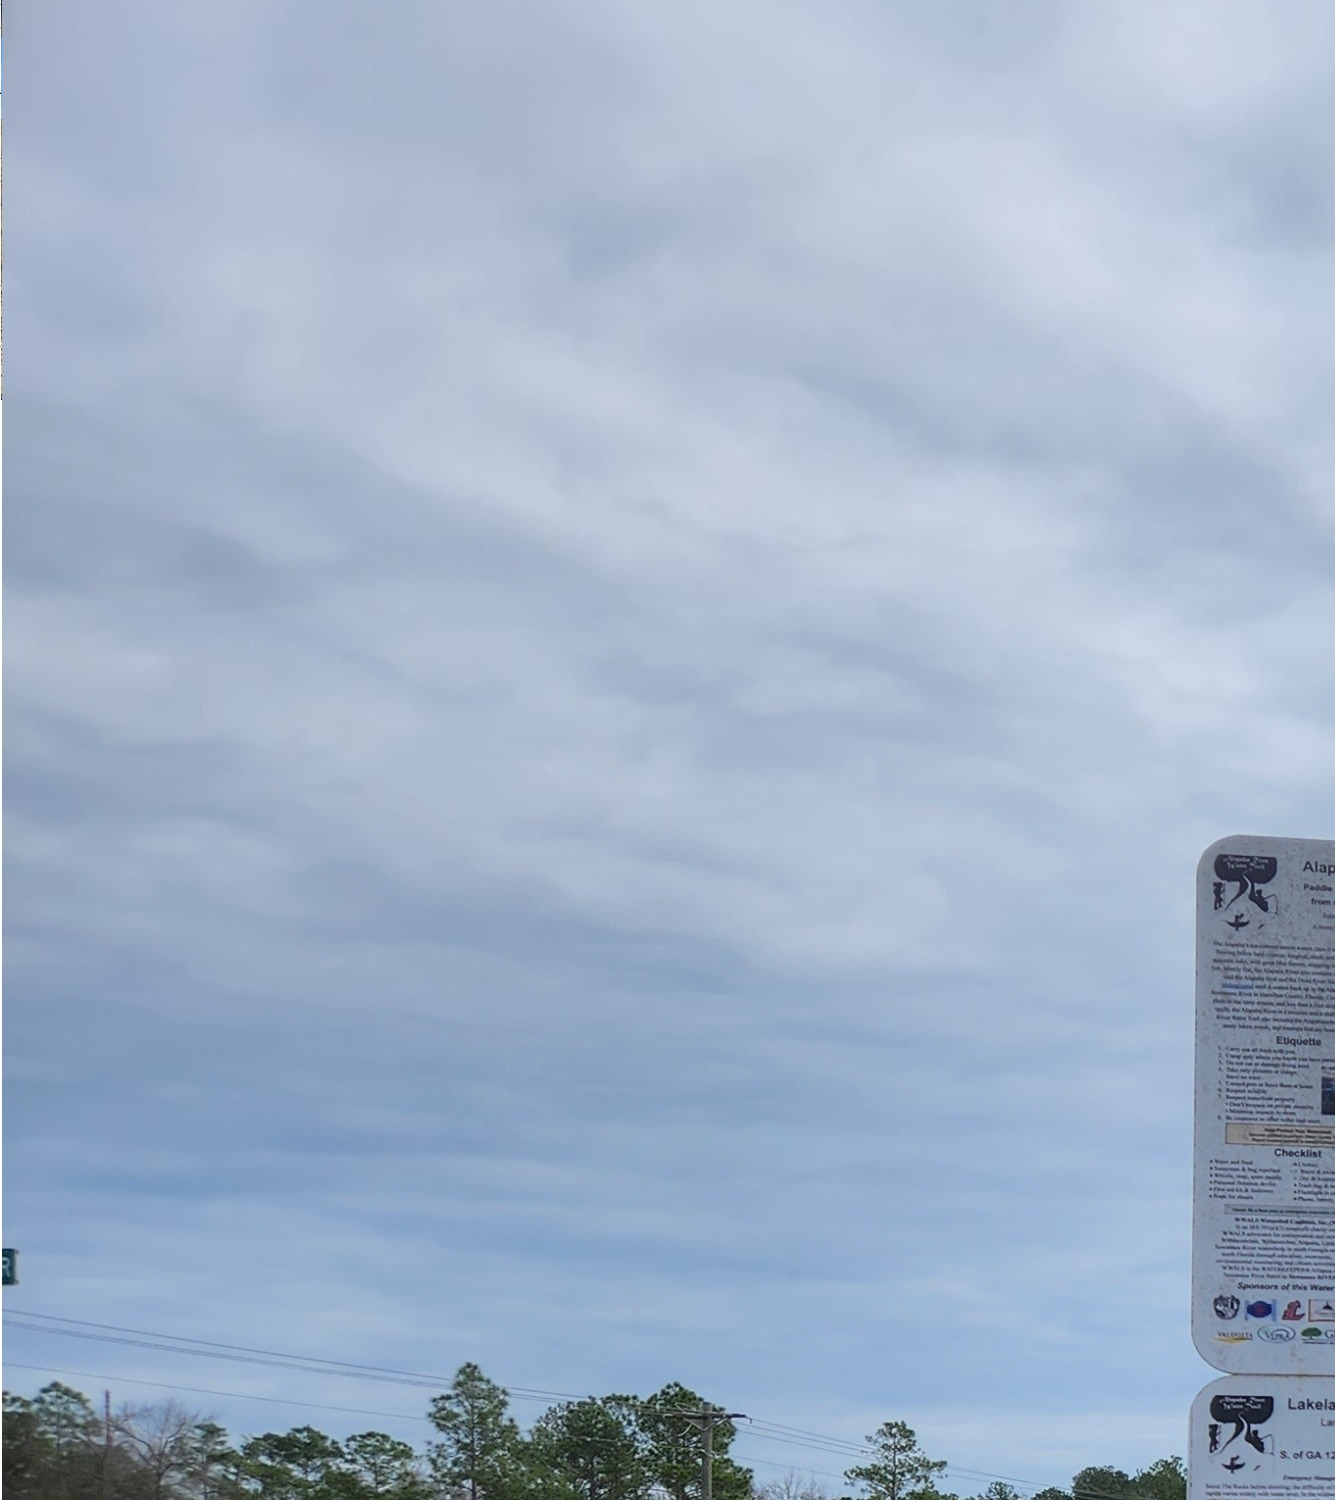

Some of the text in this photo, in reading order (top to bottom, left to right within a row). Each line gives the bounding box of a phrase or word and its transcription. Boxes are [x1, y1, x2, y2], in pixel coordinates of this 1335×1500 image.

[1303, 884, 1333, 892] Paddle
[1311, 898, 1331, 906] from
[1276, 1036, 1322, 1048] Etiquette
[1274, 1148, 1322, 1158] Checklist
[1237, 1282, 1279, 1292] Sponsors
[1281, 1283, 1290, 1291] of
[1292, 1283, 1308, 1292] this
[1310, 1284, 1335, 1292] Water
[1280, 1451, 1290, 1460] S.
[1292, 1451, 1304, 1460] of
[1306, 1451, 1322, 1460] GA
